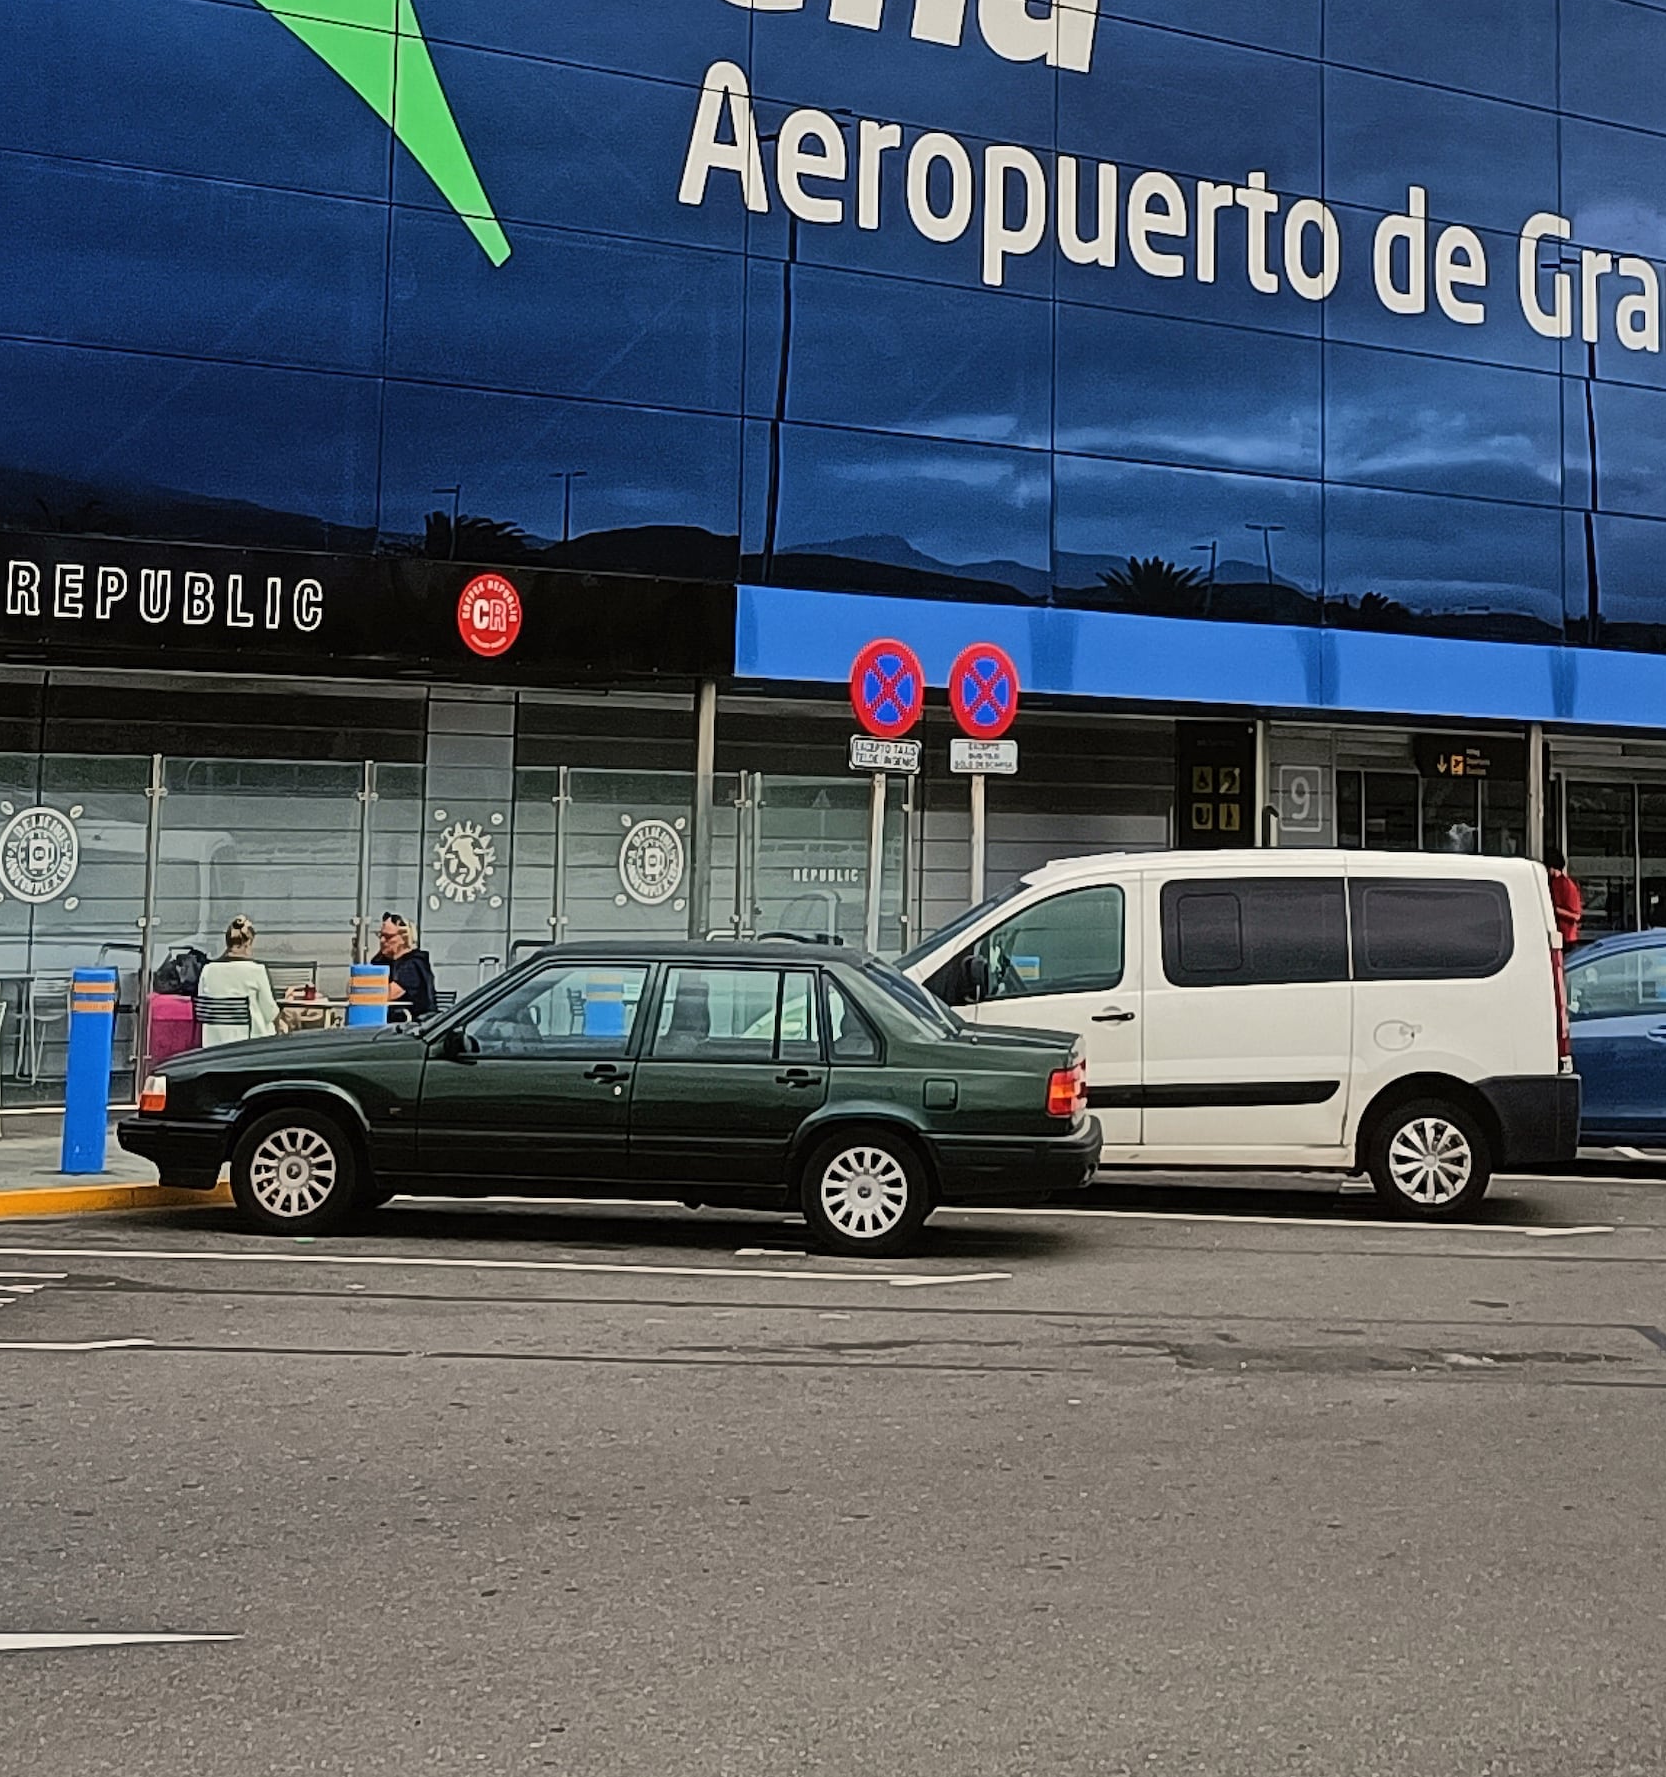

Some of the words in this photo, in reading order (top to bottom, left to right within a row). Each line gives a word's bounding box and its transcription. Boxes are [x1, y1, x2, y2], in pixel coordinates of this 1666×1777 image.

[677, 60, 1341, 302] Aeropuerto
[1372, 186, 1487, 325] de
[5, 559, 325, 632] REPUBLIC
[473, 598, 507, 632] CR
[1290, 775, 1311, 820] 9
[12, 815, 73, 853] DELICIOUS
[433, 820, 497, 862] ITALIAN
